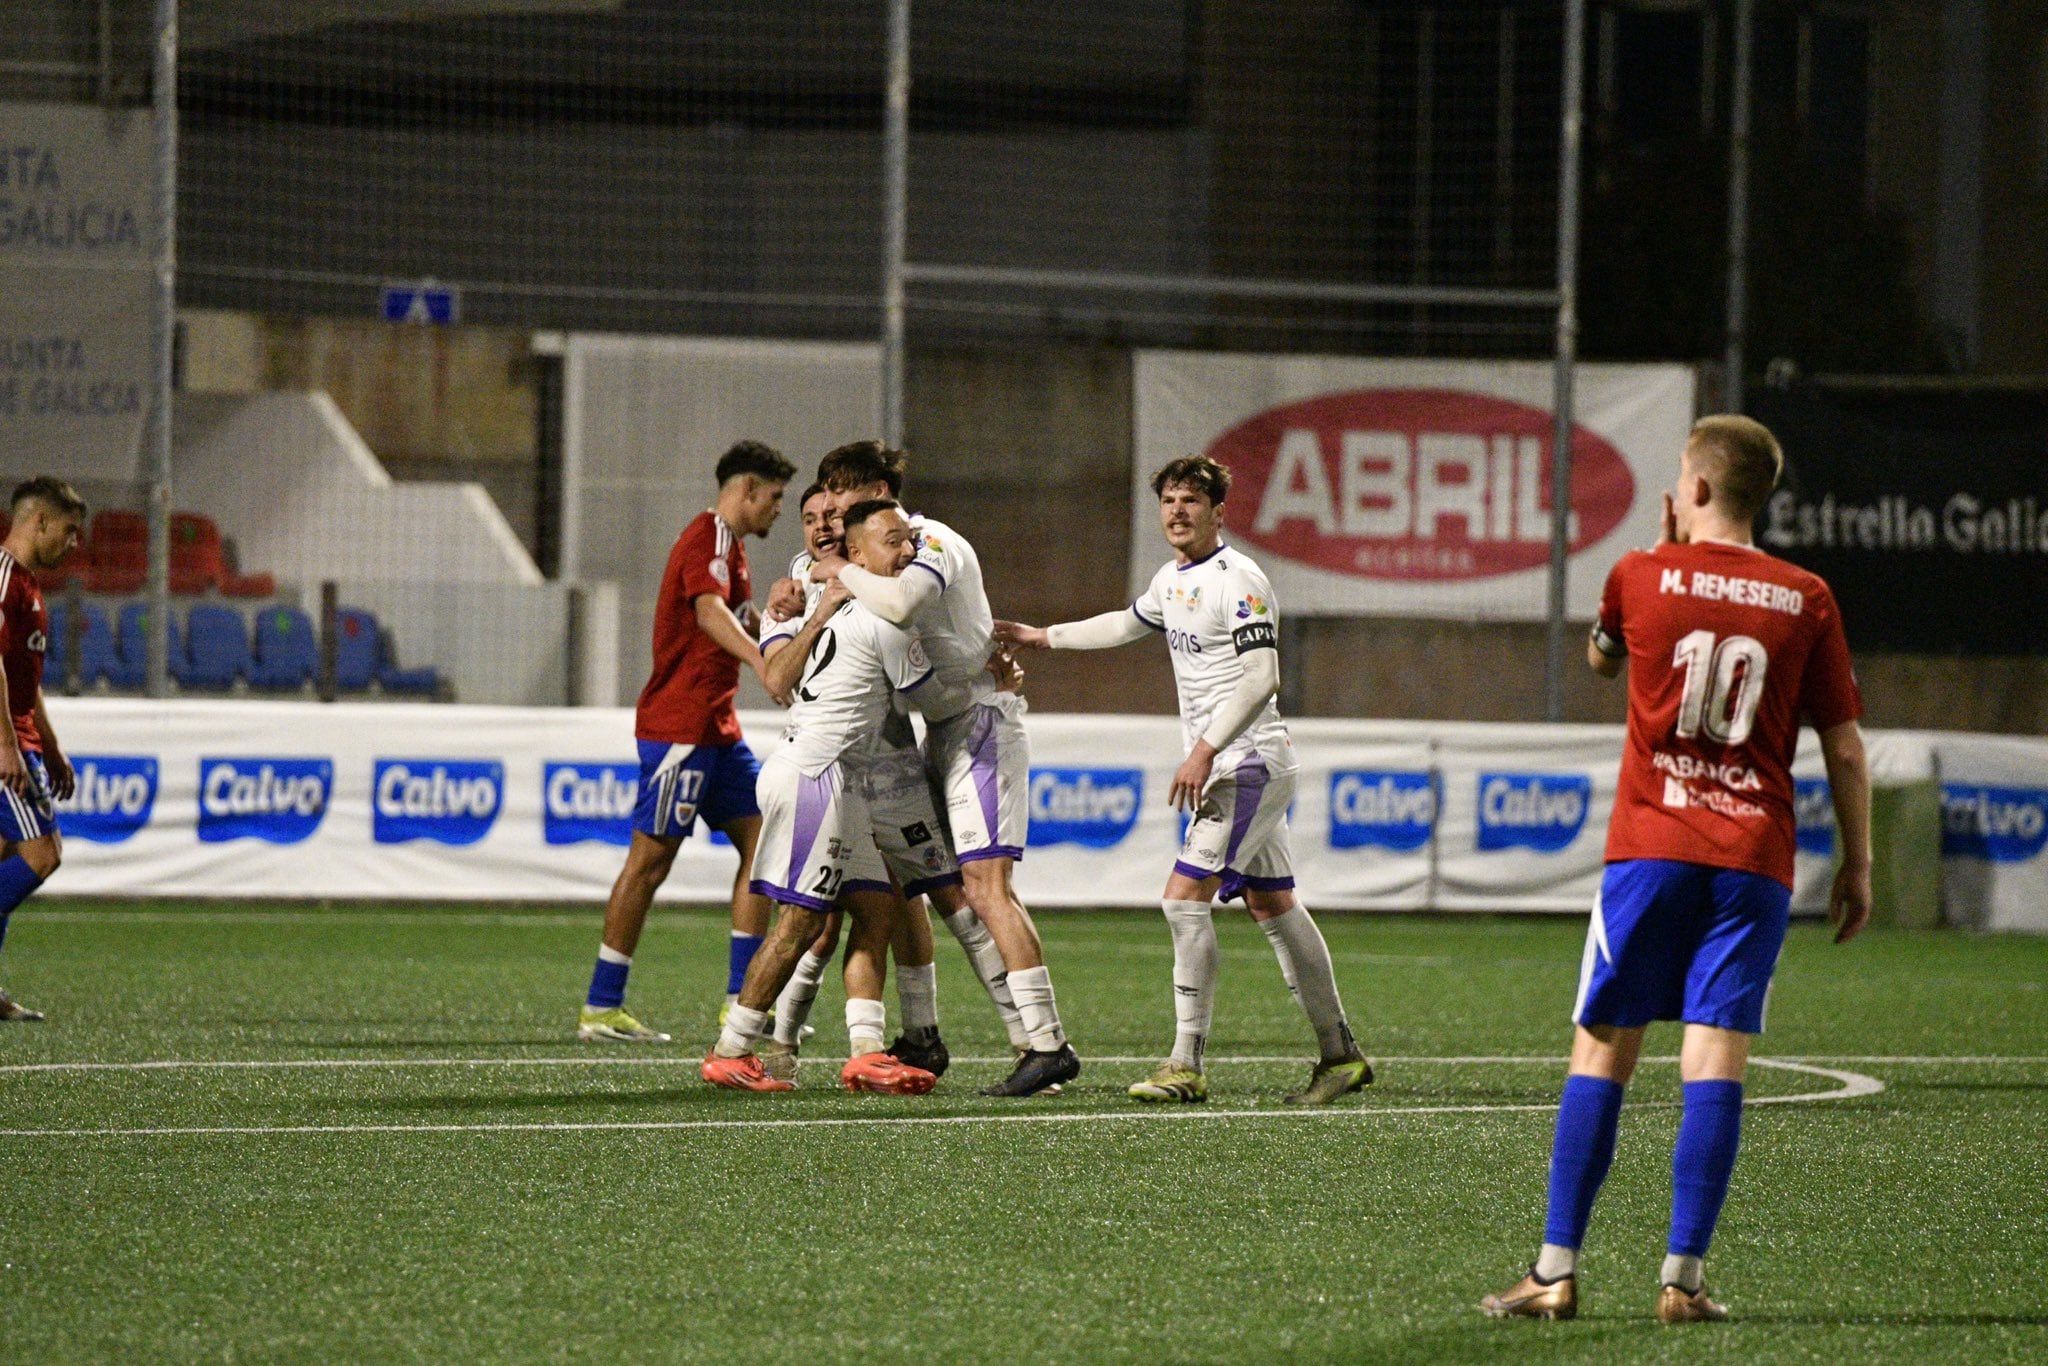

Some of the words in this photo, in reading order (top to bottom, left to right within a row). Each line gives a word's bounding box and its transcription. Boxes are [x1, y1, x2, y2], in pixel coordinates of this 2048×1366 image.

[0, 337, 84, 370] UNTA
[1254, 428, 1578, 543] ABRIL
[1764, 489, 1936, 550] Estrella
[1659, 568, 1687, 595] M.
[1691, 571, 1804, 616] REMESEIRO
[1671, 628, 1770, 746] 10
[57, 763, 149, 816] alvo
[203, 762, 324, 815] Calvo
[377, 763, 496, 817] Calvo
[548, 764, 639, 819] Calv
[679, 770, 704, 801] 17
[1029, 771, 1135, 823] Calvo
[1480, 773, 1580, 828] Calvo
[1941, 789, 2046, 840] alvo
[812, 865, 844, 897] 22
